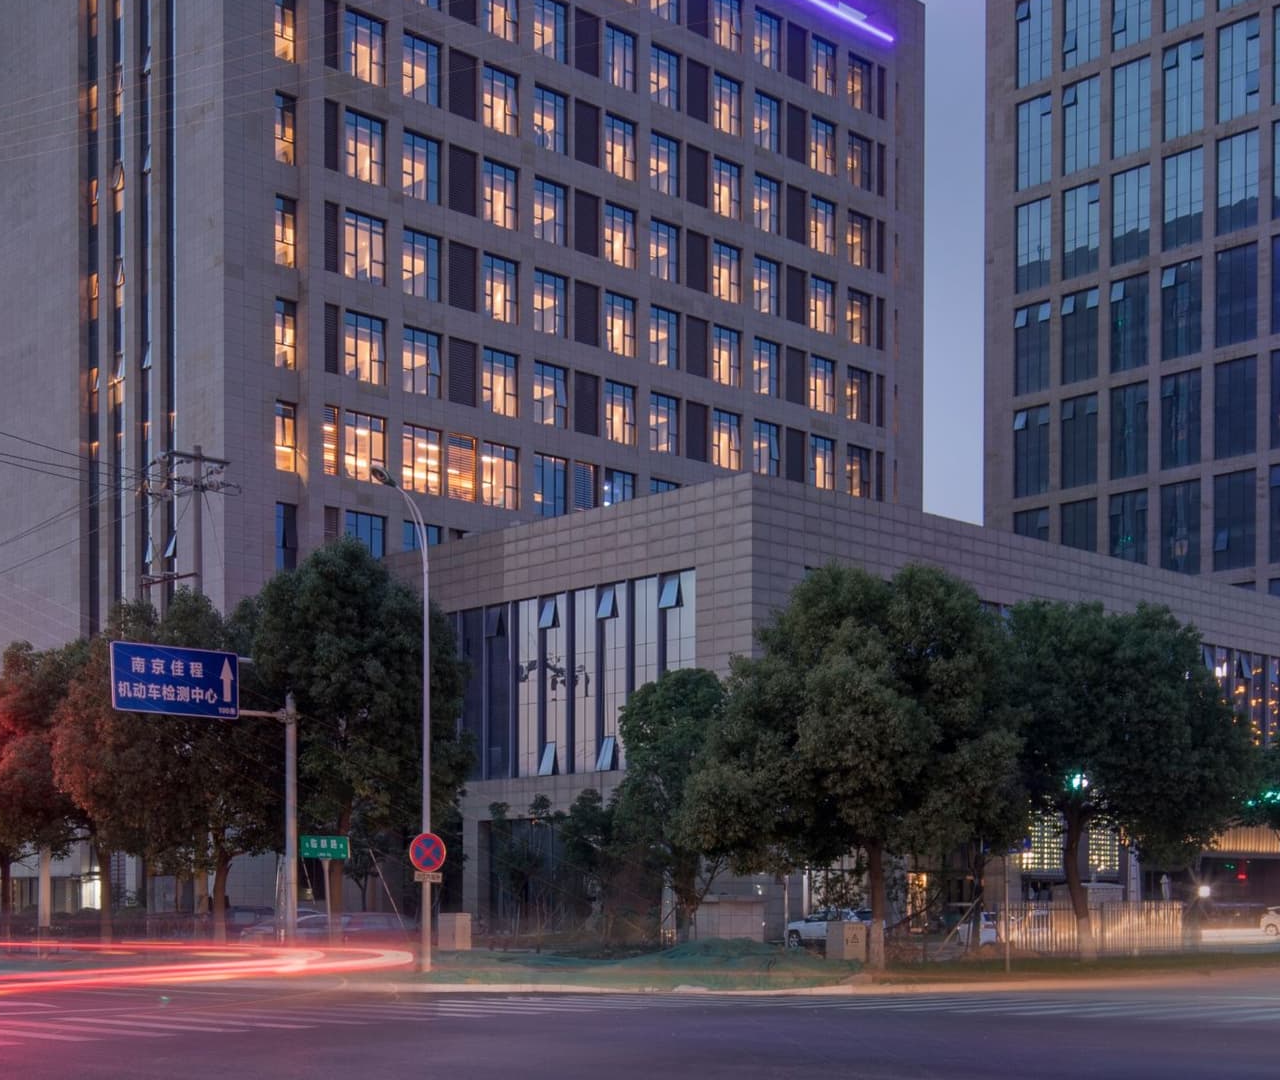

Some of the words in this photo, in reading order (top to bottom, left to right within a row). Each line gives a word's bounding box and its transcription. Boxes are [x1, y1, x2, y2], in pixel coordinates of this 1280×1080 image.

[131, 657, 204, 678] 南京佳程
[118, 681, 218, 704] 机动车检测中心
